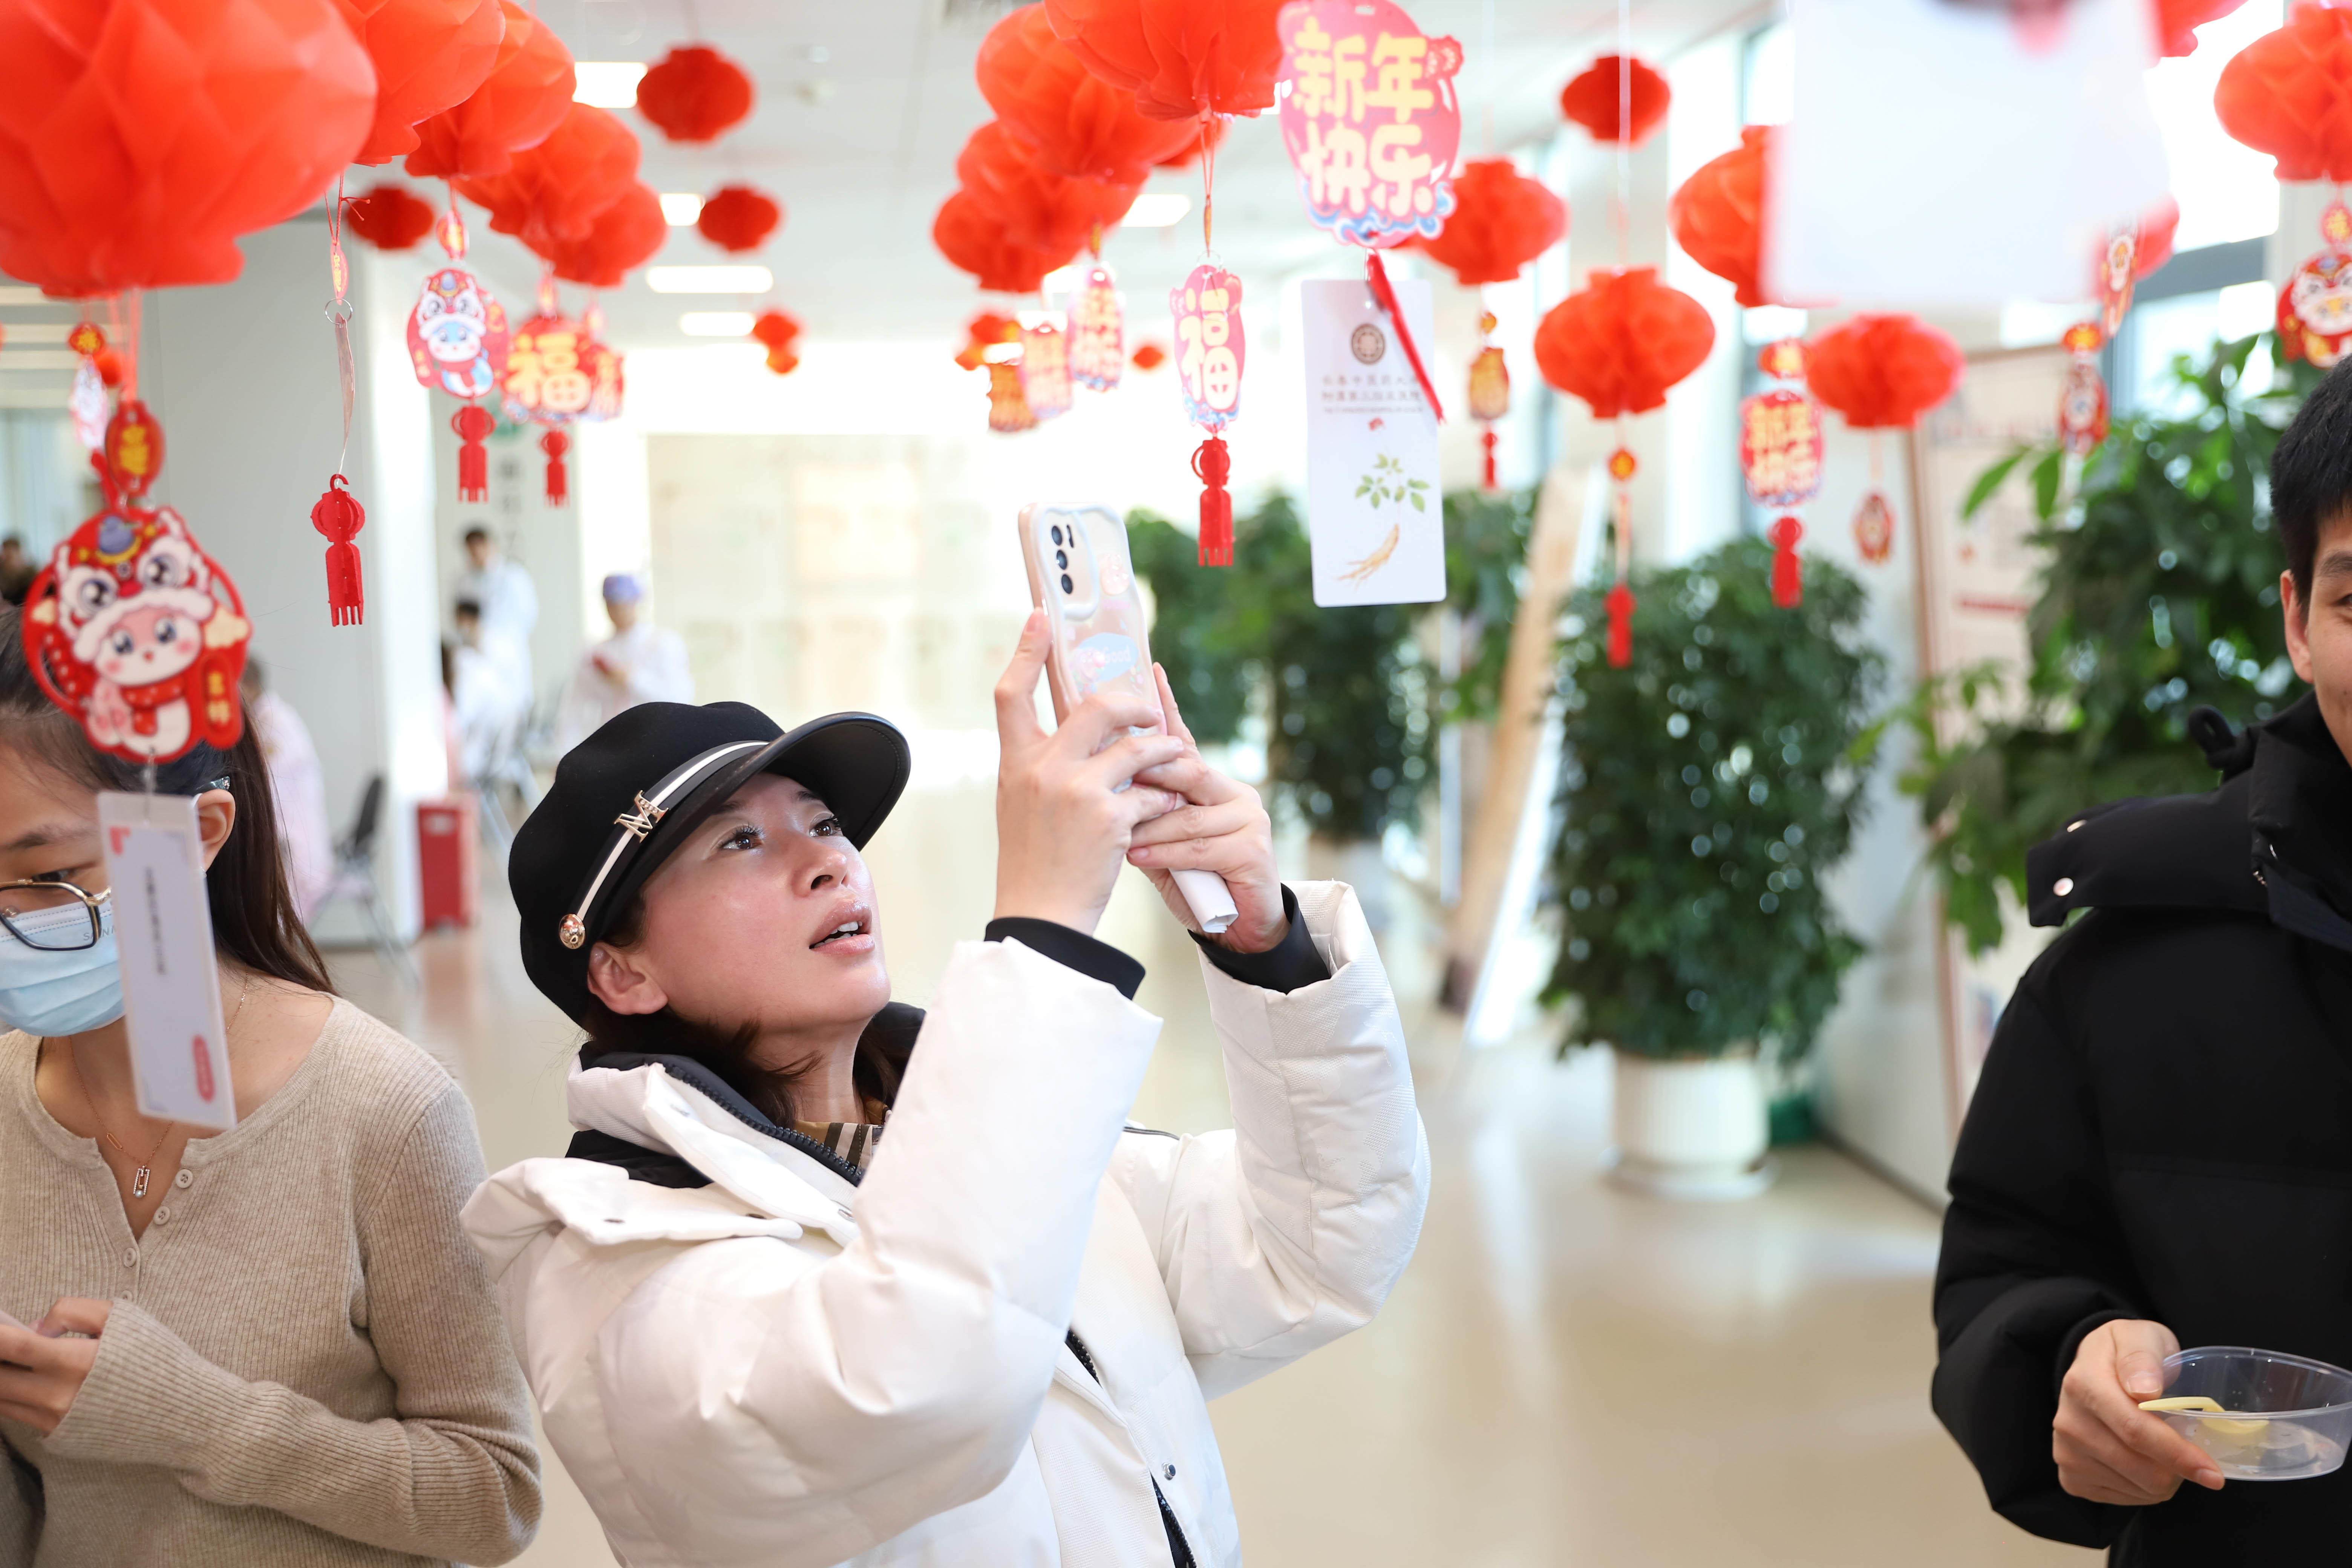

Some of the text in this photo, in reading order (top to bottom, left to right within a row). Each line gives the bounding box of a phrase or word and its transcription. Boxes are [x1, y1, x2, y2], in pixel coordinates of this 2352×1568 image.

[1292, 15, 1434, 124] 新年
[1299, 120, 1434, 217] 快乐
[507, 332, 592, 412] 福
[1178, 287, 1238, 410] 福
